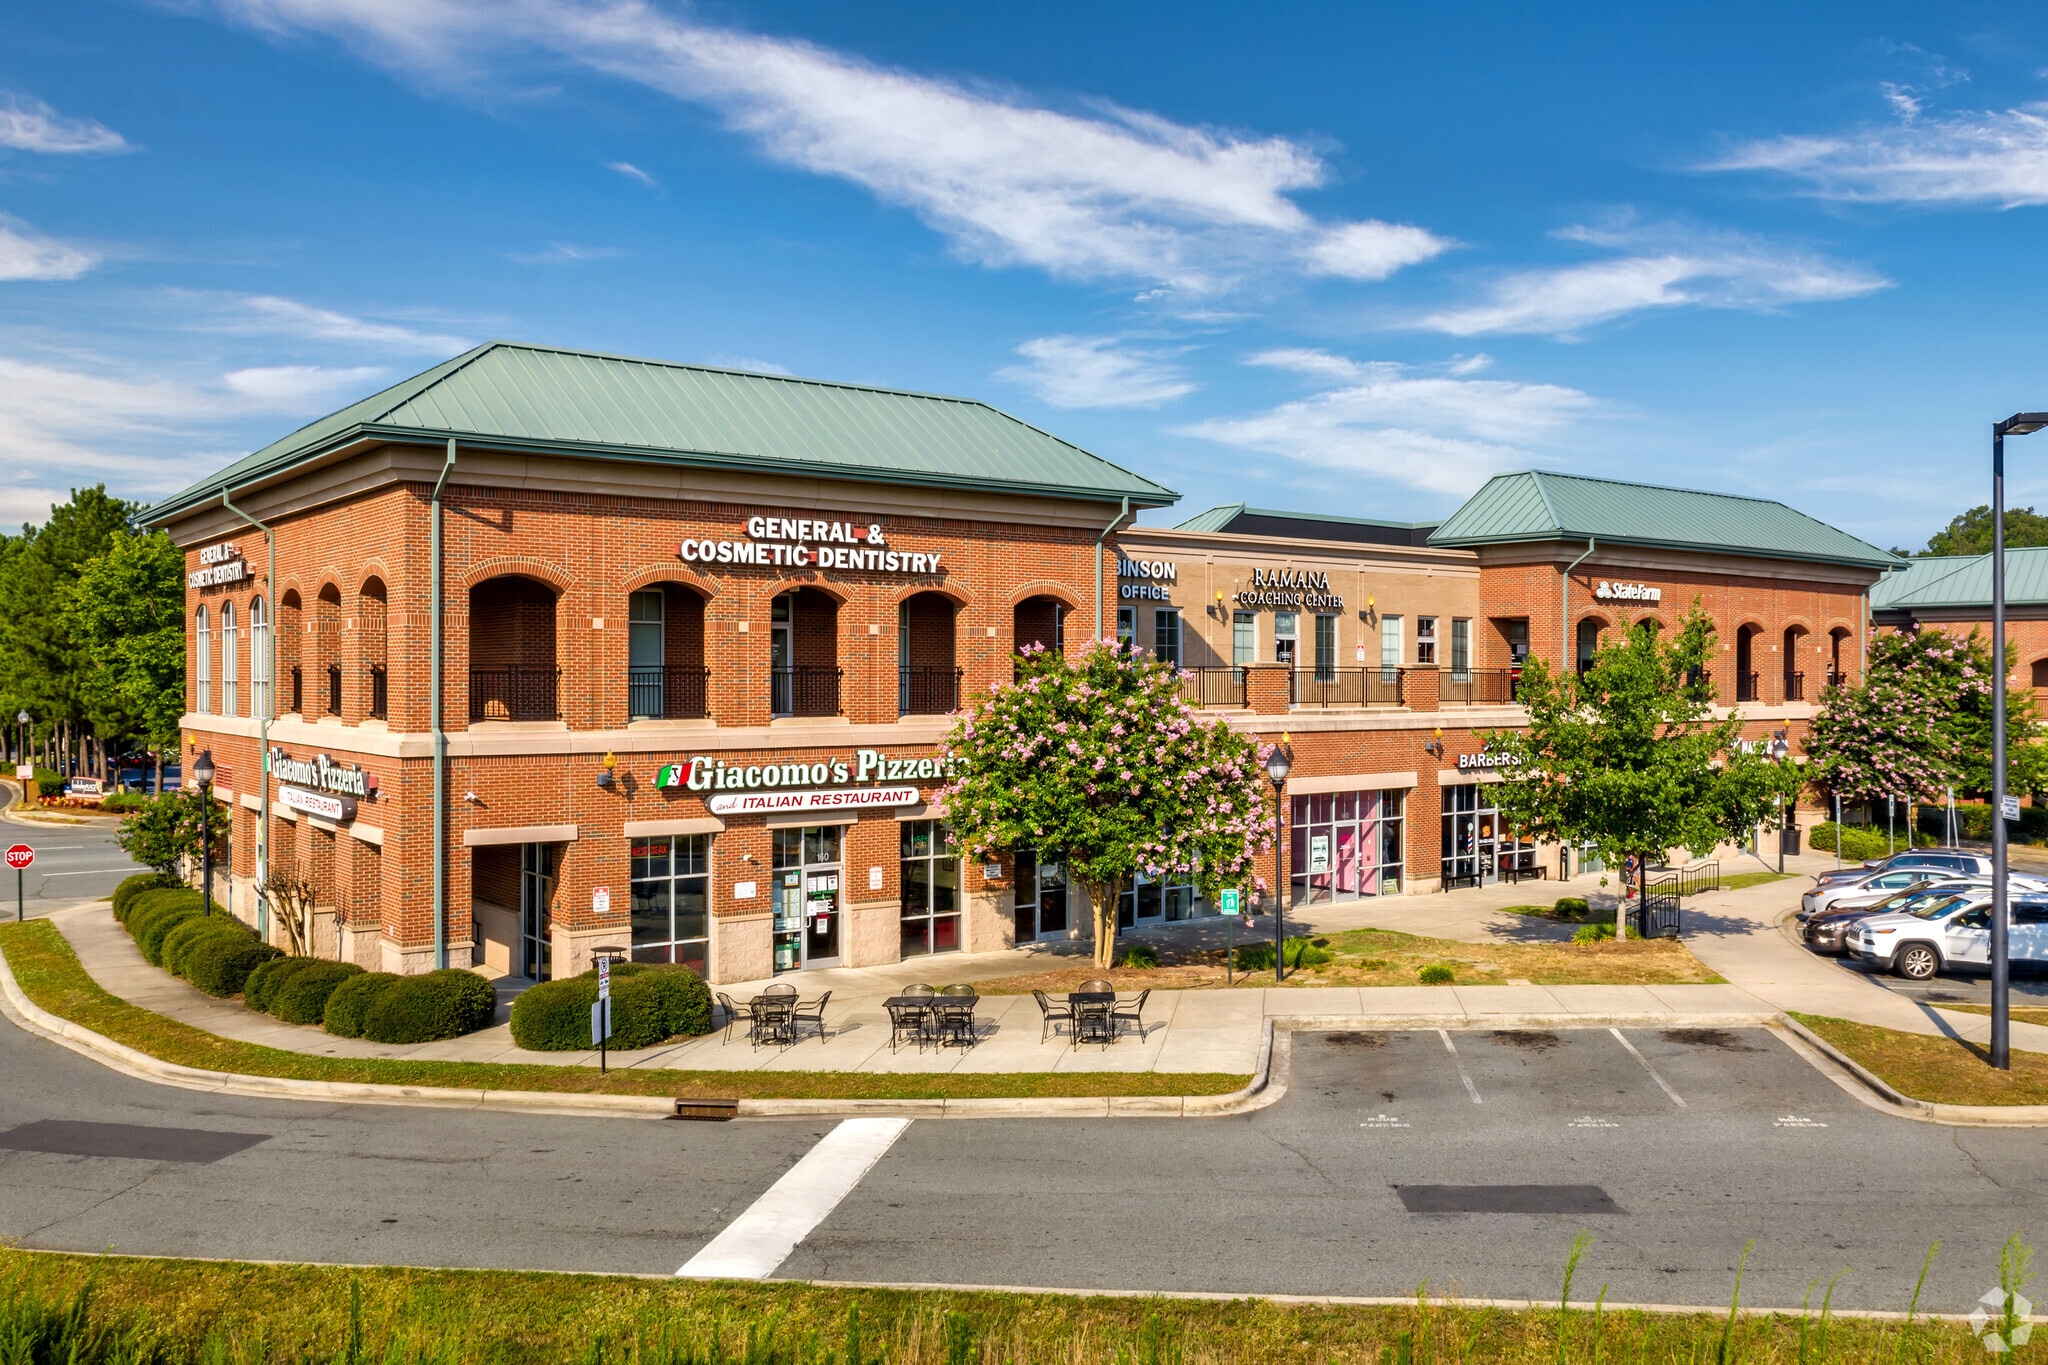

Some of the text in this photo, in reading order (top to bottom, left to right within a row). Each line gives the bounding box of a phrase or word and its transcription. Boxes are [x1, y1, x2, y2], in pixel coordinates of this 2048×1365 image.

[749, 516, 885, 545] GENERAL &
[201, 544, 223, 565] GENERAL
[680, 539, 942, 574] COSMETIC DENTISTRY
[189, 561, 243, 589] COSMETIC DENTISTRY
[1254, 568, 1331, 589] RAMANA
[1121, 585, 1170, 600] OFFICE
[1240, 592, 1345, 607] COACHING CENTER
[272, 746, 319, 787] Giacomo's
[318, 753, 365, 796] Pizzeria
[687, 755, 849, 791] Giacomo's
[305, 796, 340, 814] RESTAURANT
[716, 791, 912, 811] and ITALIAN RESTAURANT
[7, 851, 33, 862] STOP
